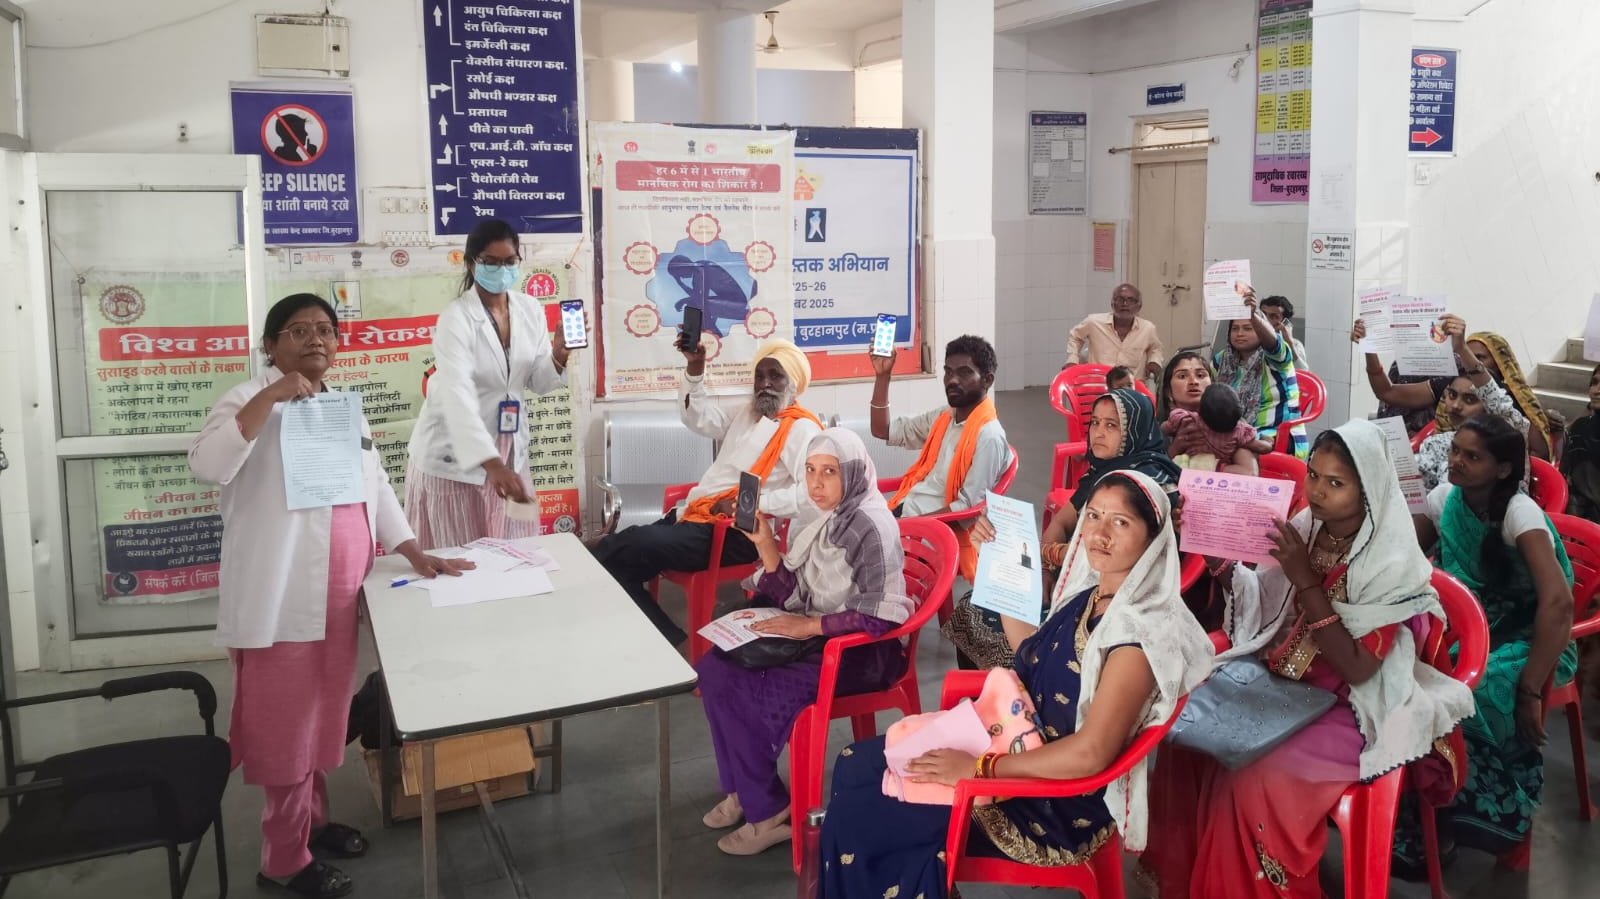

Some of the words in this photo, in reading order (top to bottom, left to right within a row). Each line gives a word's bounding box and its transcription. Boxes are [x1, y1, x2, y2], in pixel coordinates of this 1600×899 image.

[495, 5, 541, 19] चिकित्सा
[542, 10, 562, 20] कक्ष
[464, 21, 479, 32] दंत
[481, 21, 526, 35] चिकित्सा
[527, 26, 548, 36] कक्ष
[509, 42, 531, 52] कक्ष
[466, 71, 493, 84] रसोई
[494, 75, 516, 85] कक्ष
[504, 92, 536, 102] भण्डार
[537, 93, 557, 103] कक्ष
[468, 123, 491, 135] पीने
[492, 125, 507, 134] का
[509, 123, 534, 135] पानी
[553, 143, 573, 153] कक्ष
[508, 158, 529, 168] कक्ष
[656, 167, 668, 176] हर
[679, 164, 689, 176] में
[690, 165, 700, 176] से
[712, 166, 750, 177] भारतीय
[1255, 168, 1286, 184] सामुदायिक
[286, 173, 346, 192] SILENCE
[637, 178, 680, 189] मानसिक
[682, 177, 698, 189] रोग
[701, 180, 715, 189] का
[717, 178, 750, 190] शिकार
[509, 190, 544, 201] वितरण
[545, 192, 566, 201] कक्ष
[275, 195, 301, 211] शांती
[302, 196, 328, 211] बनाये
[331, 196, 350, 211] रखे
[472, 205, 495, 217] रैम्प
[828, 252, 890, 273] अभियान
[792, 281, 827, 291] 25-26
[809, 298, 835, 309] 2025
[800, 324, 850, 341] बुरहानपुर
[119, 333, 198, 355] विश्व
[206, 335, 248, 352] आ
[360, 353, 371, 365] के
[375, 352, 409, 364] कारण
[96, 364, 138, 380] सुसाइड
[140, 362, 167, 376] करने
[169, 361, 196, 376] वालों
[198, 361, 211, 373] के
[214, 361, 245, 374] लक्षण
[106, 382, 131, 394] अपने
[133, 382, 154, 392] आप
[156, 382, 164, 391] में
[191, 380, 213, 390] रहना
[349, 381, 388, 393] बाइपोलर
[107, 396, 154, 407] अकेलापन
[156, 395, 165, 405] में
[167, 396, 189, 405] रहना
[545, 424, 554, 432] ना
[540, 436, 558, 446] शेयर
[560, 433, 572, 444] करें
[138, 464, 149, 477] के
[151, 463, 172, 474] बीच
[114, 478, 139, 490] जीवन
[158, 478, 187, 488] अच्छा
[548, 475, 556, 485] से
[557, 474, 574, 485] मिले
[123, 508, 165, 521] जीवन
[168, 505, 188, 517] का
[171, 571, 188, 587] करें
